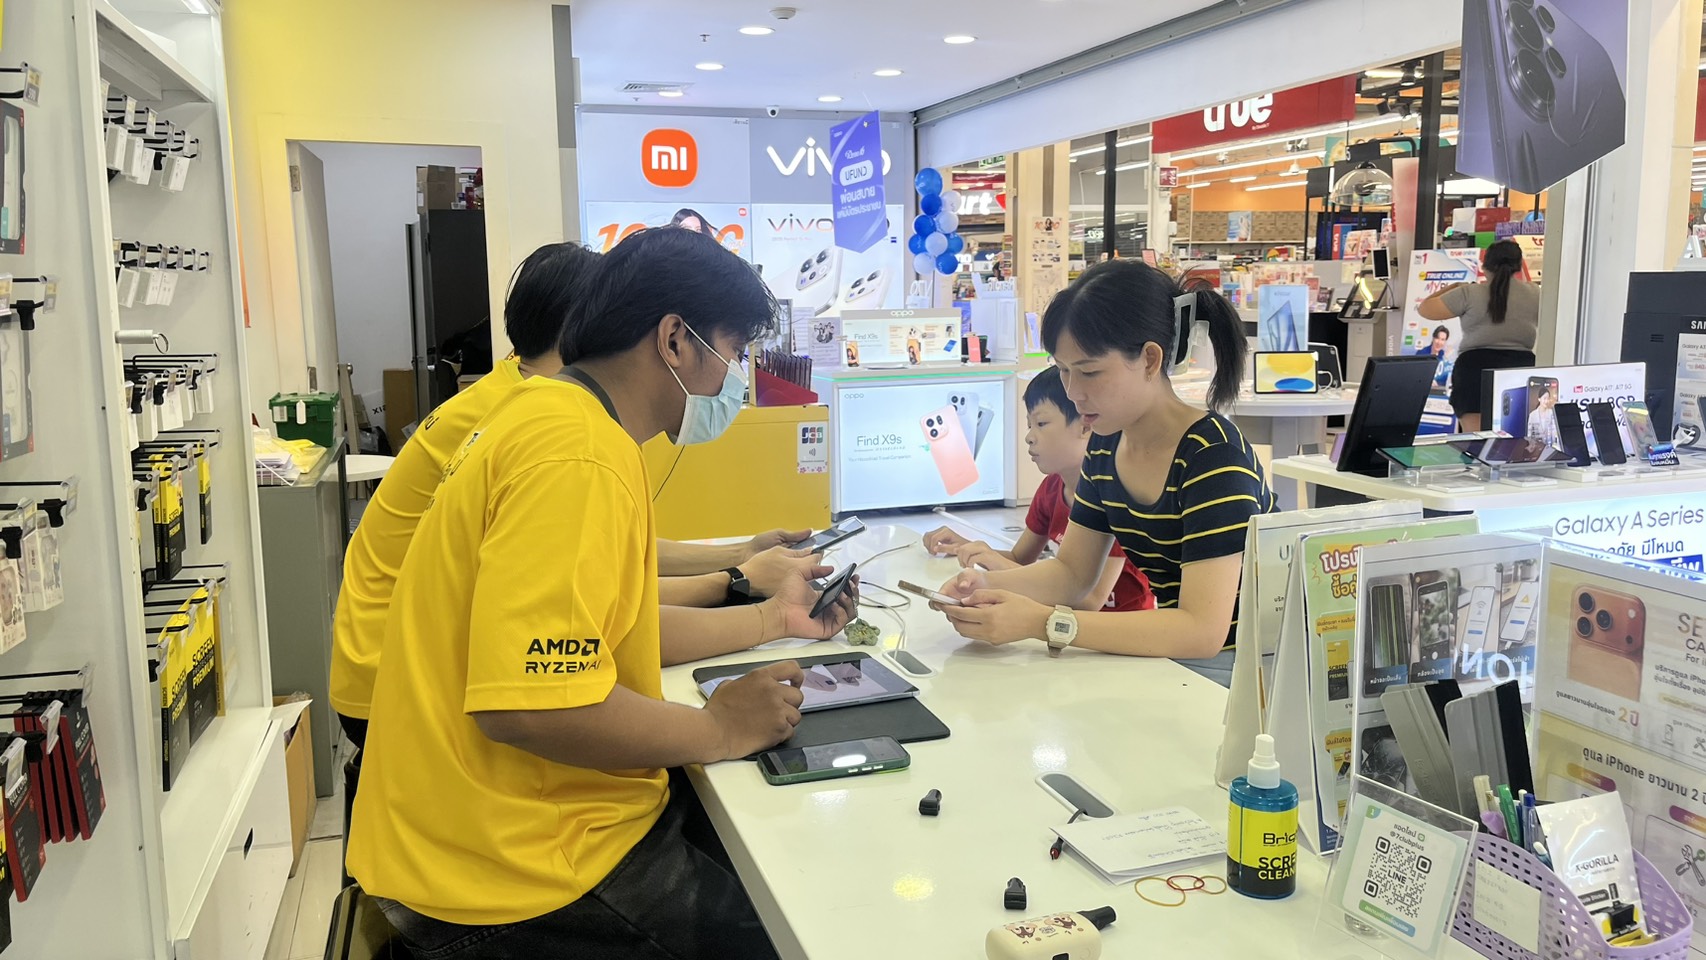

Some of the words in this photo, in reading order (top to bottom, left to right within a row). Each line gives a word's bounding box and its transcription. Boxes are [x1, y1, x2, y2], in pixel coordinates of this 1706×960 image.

[1584, 386, 1604, 394] Galaxy
[857, 435, 879, 446] Find
[882, 434, 902, 445] X9s
[1555, 515, 1628, 536] Galaxy
[1630, 511, 1643, 530] A
[1647, 505, 1704, 528] Series
[1641, 538, 1684, 556] มีโหมด
[1678, 612, 1706, 638] SE
[526, 638, 580, 655] AMD
[1686, 638, 1706, 654] CA
[1686, 653, 1700, 664] For
[526, 661, 588, 673] RYZEN
[1618, 707, 1628, 722] 2
[1630, 710, 1639, 727] ปี
[1583, 747, 1603, 764] ดูแล
[1606, 754, 1645, 779] iPhone
[1648, 773, 1687, 797] ยาวนาน
[1691, 789, 1699, 802] 2
[1263, 832, 1297, 845] Brig
[1389, 831, 1425, 851] @7clubplus
[1258, 854, 1296, 870] SCRE
[1575, 854, 1620, 873] X-GORILLA
[1258, 869, 1295, 880] CLEAN
[1388, 869, 1407, 884] LINE
